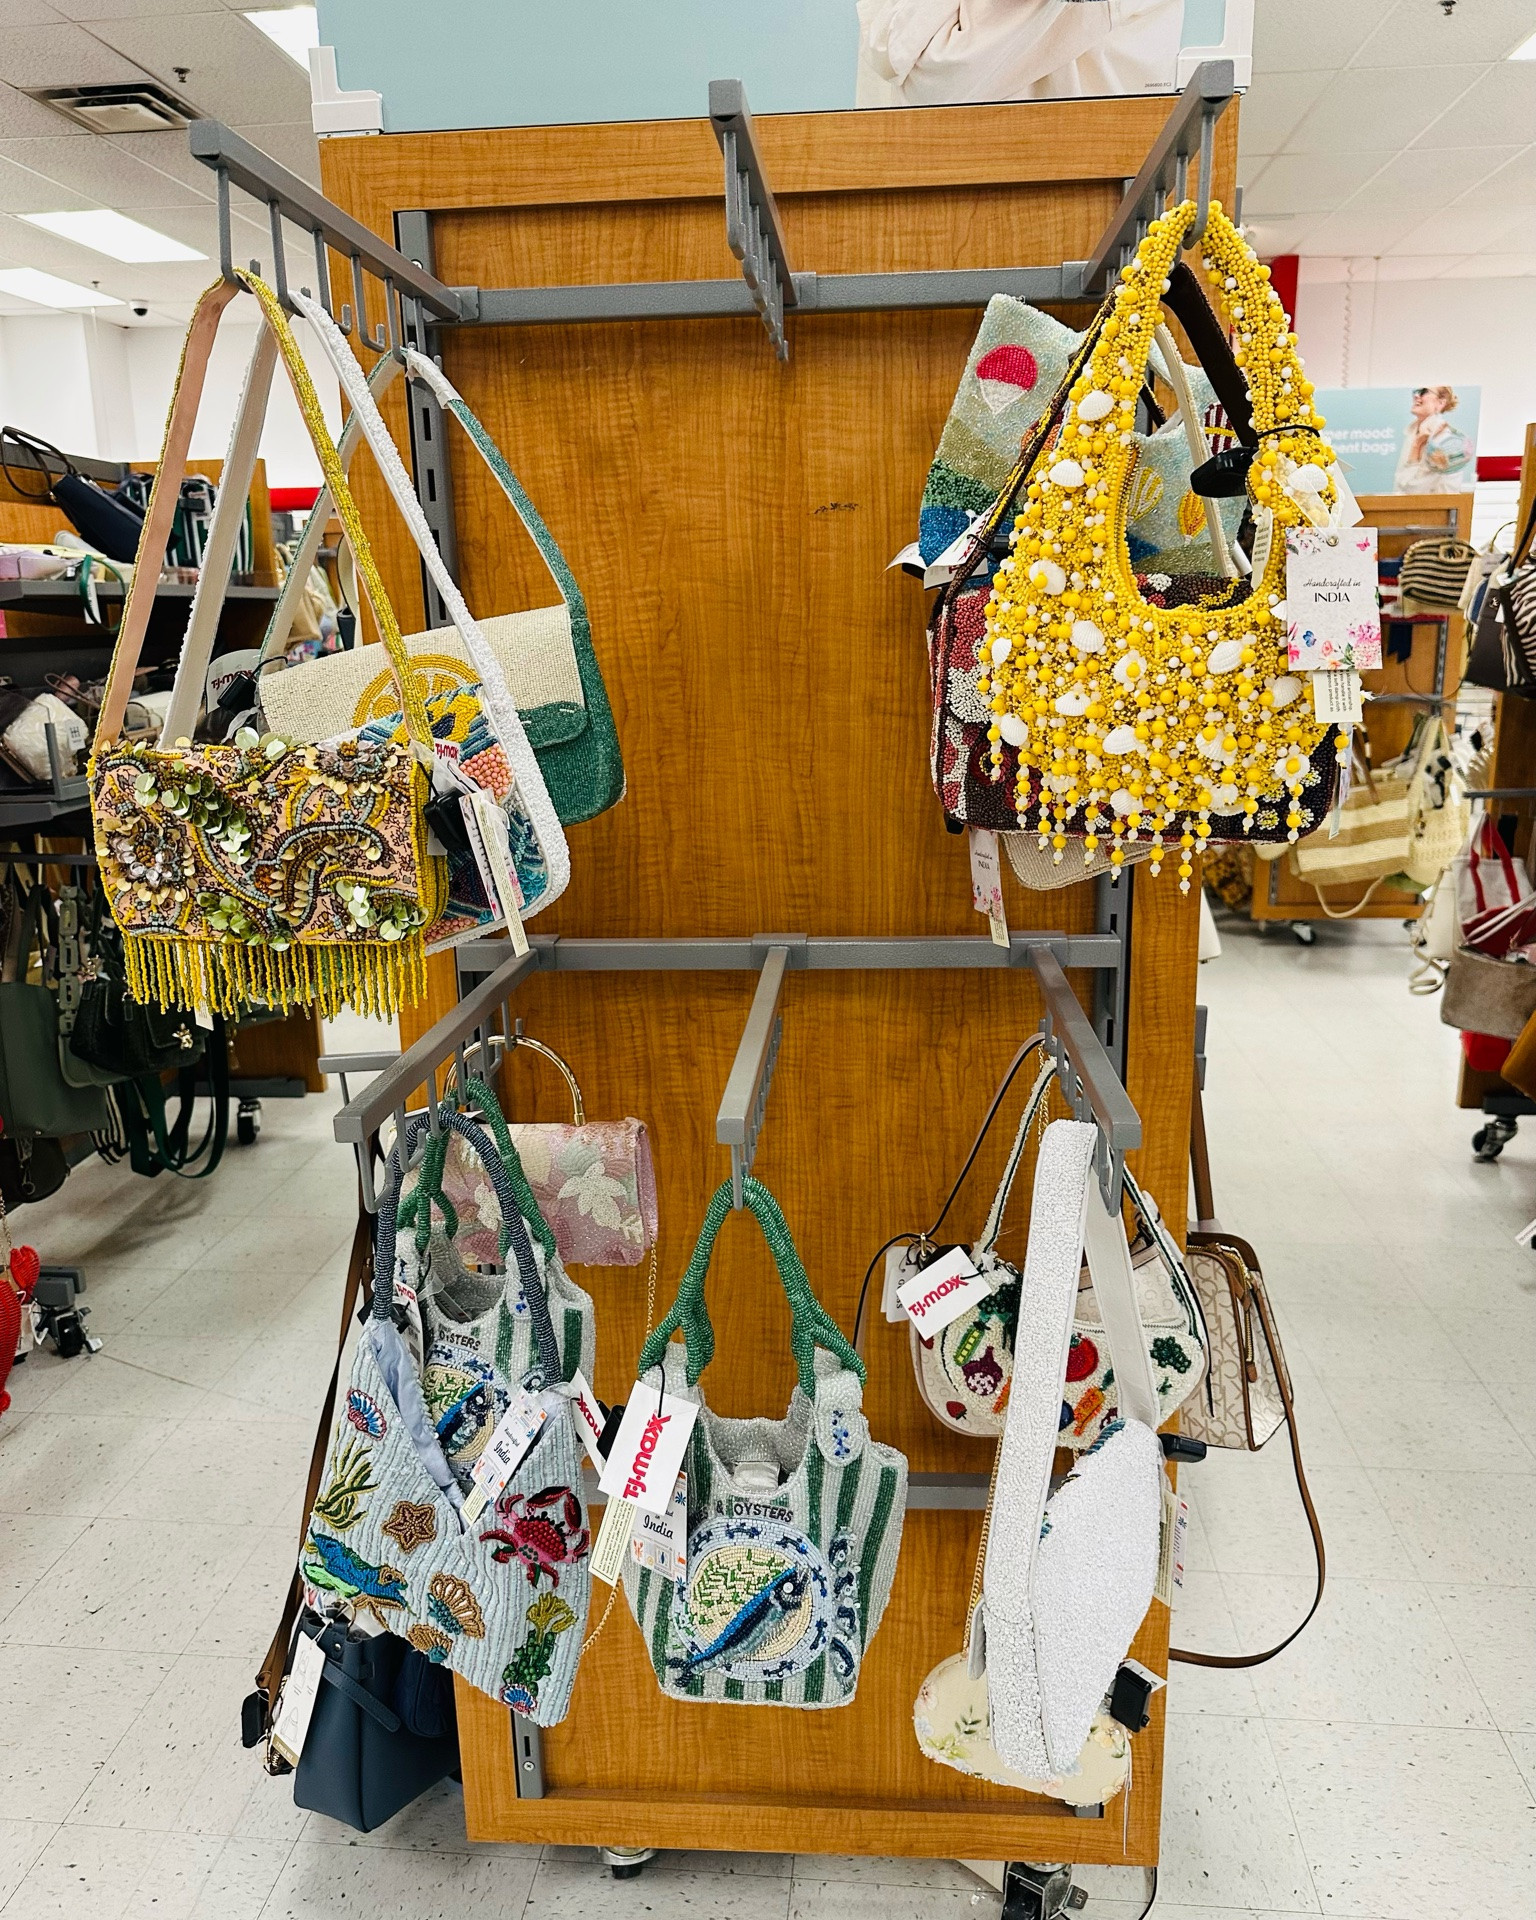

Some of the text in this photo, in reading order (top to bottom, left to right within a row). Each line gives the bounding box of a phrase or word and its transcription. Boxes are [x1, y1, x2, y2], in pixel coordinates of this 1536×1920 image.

[1349, 427, 1395, 440] mood:
[1361, 441, 1396, 456] bags
[1303, 578, 1361, 589] Handcrafted in
[1314, 592, 1351, 603] INDIA
[493, 1440, 511, 1465] India
[716, 1499, 724, 1516] &
[733, 1502, 794, 1523] OYSTERS
[643, 1514, 674, 1540] India
